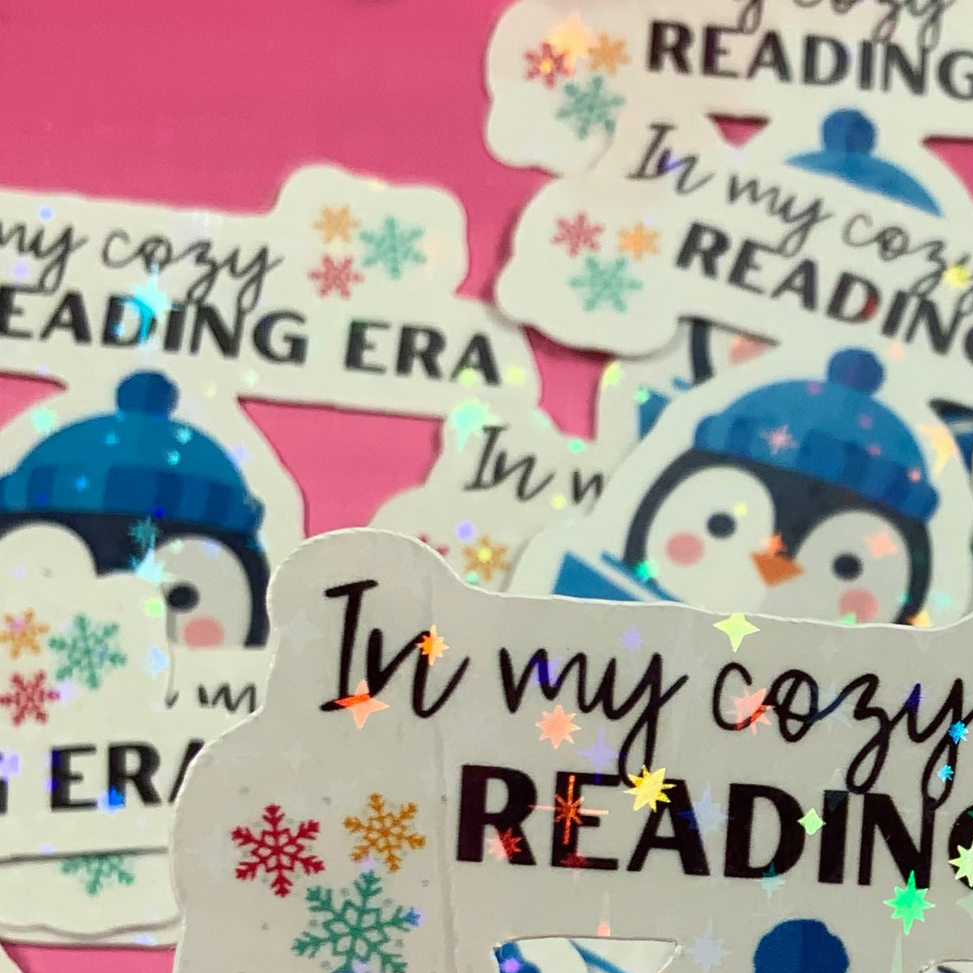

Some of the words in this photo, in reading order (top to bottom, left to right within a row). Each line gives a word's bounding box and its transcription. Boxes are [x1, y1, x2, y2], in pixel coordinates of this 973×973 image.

[626, 121, 715, 195] In
[726, 173, 836, 258] my
[101, 228, 283, 313] cozy
[0, 284, 308, 366] EADING
[343, 319, 502, 387] ERA
[463, 422, 557, 502] In
[320, 579, 471, 719] In
[498, 646, 690, 782] my
